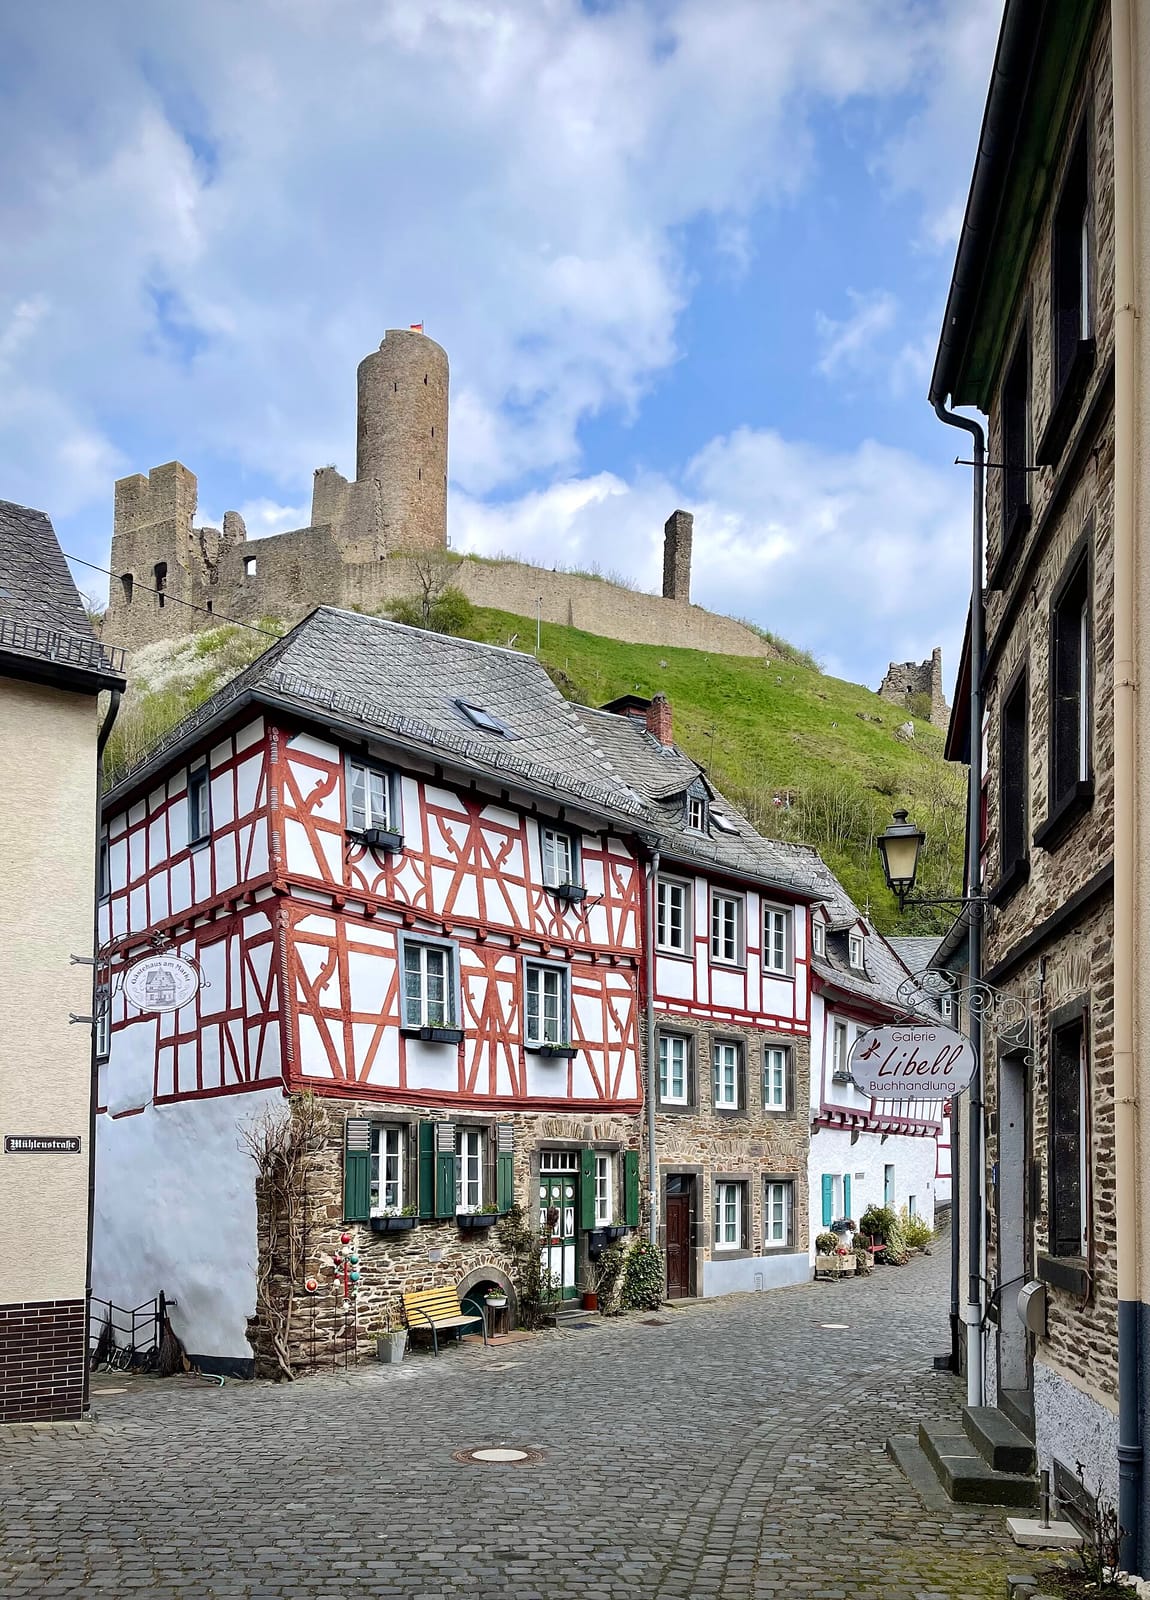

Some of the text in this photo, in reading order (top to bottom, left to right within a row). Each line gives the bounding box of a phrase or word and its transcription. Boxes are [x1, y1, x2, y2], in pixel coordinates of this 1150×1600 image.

[176, 963, 191, 982] Markt
[892, 1031, 936, 1042] Galerie
[878, 1044, 964, 1077] Libell
[869, 1080, 956, 1092] Buchhandlung
[10, 1138, 76, 1150] Mühlenstraße
